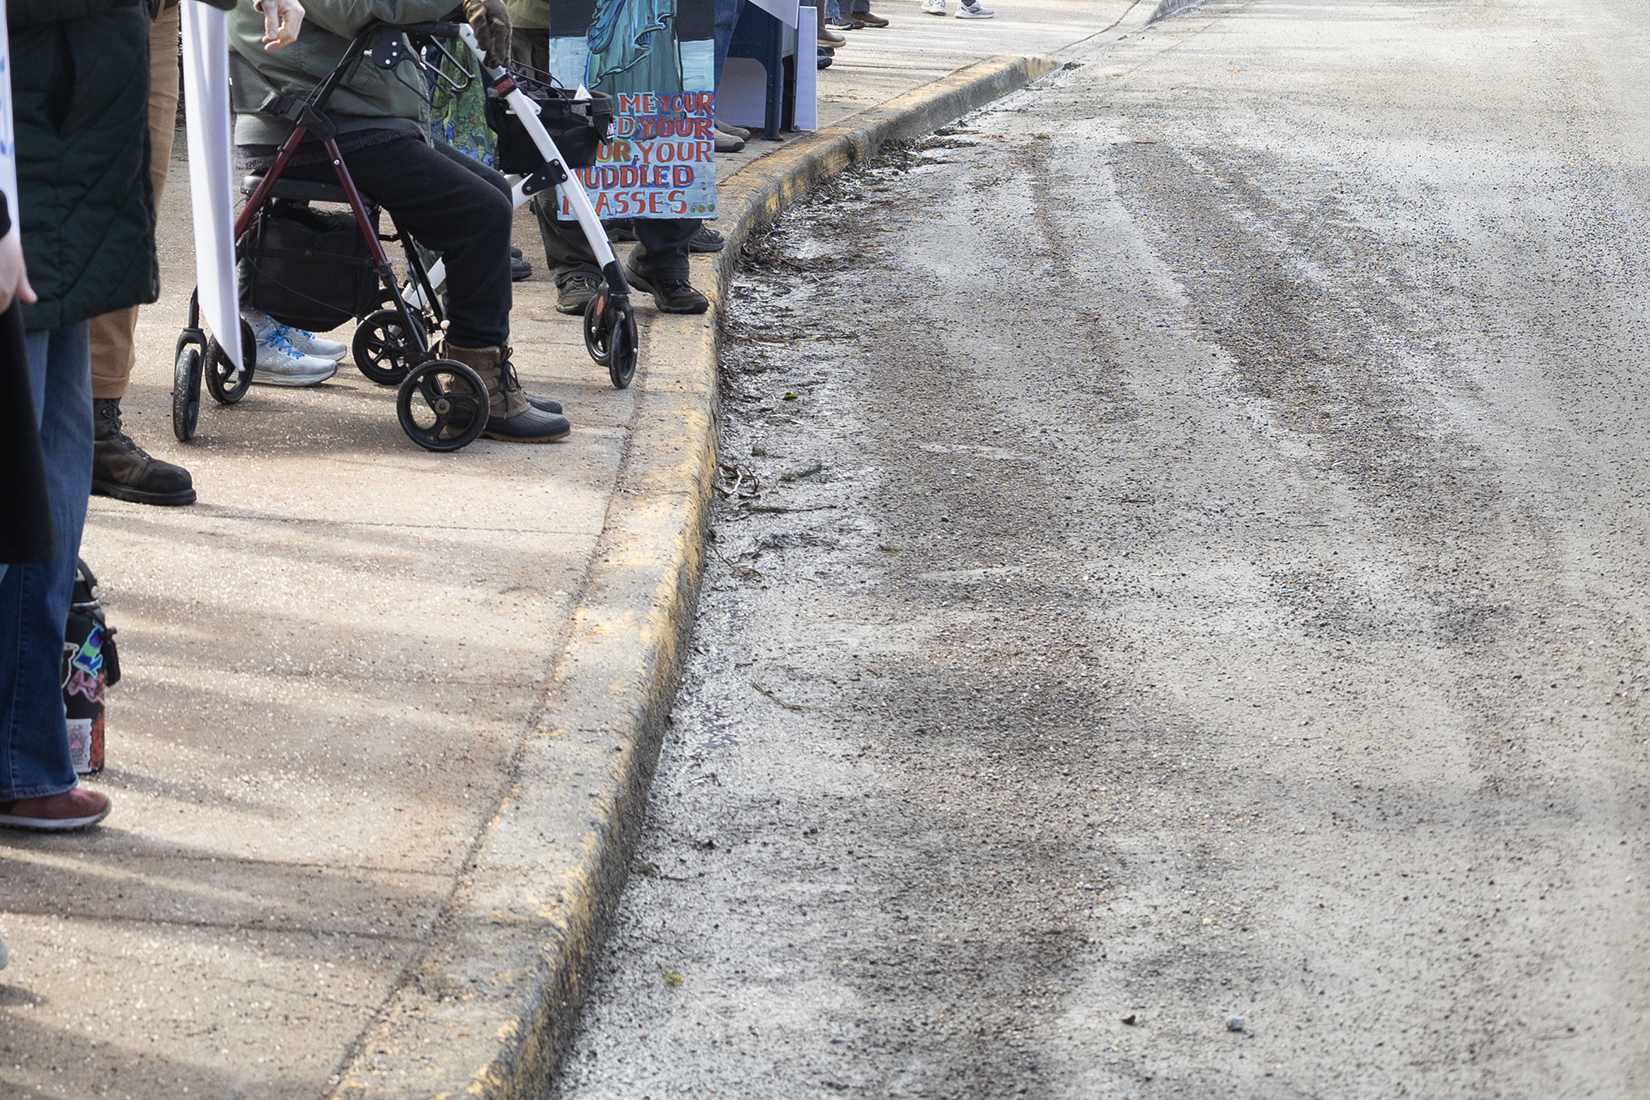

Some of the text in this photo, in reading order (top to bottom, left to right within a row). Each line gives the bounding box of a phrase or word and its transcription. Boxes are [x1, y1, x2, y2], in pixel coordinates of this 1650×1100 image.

[618, 91, 715, 117] ME YOUR
[636, 116, 715, 140] YOUR
[634, 141, 715, 165] YOUR
